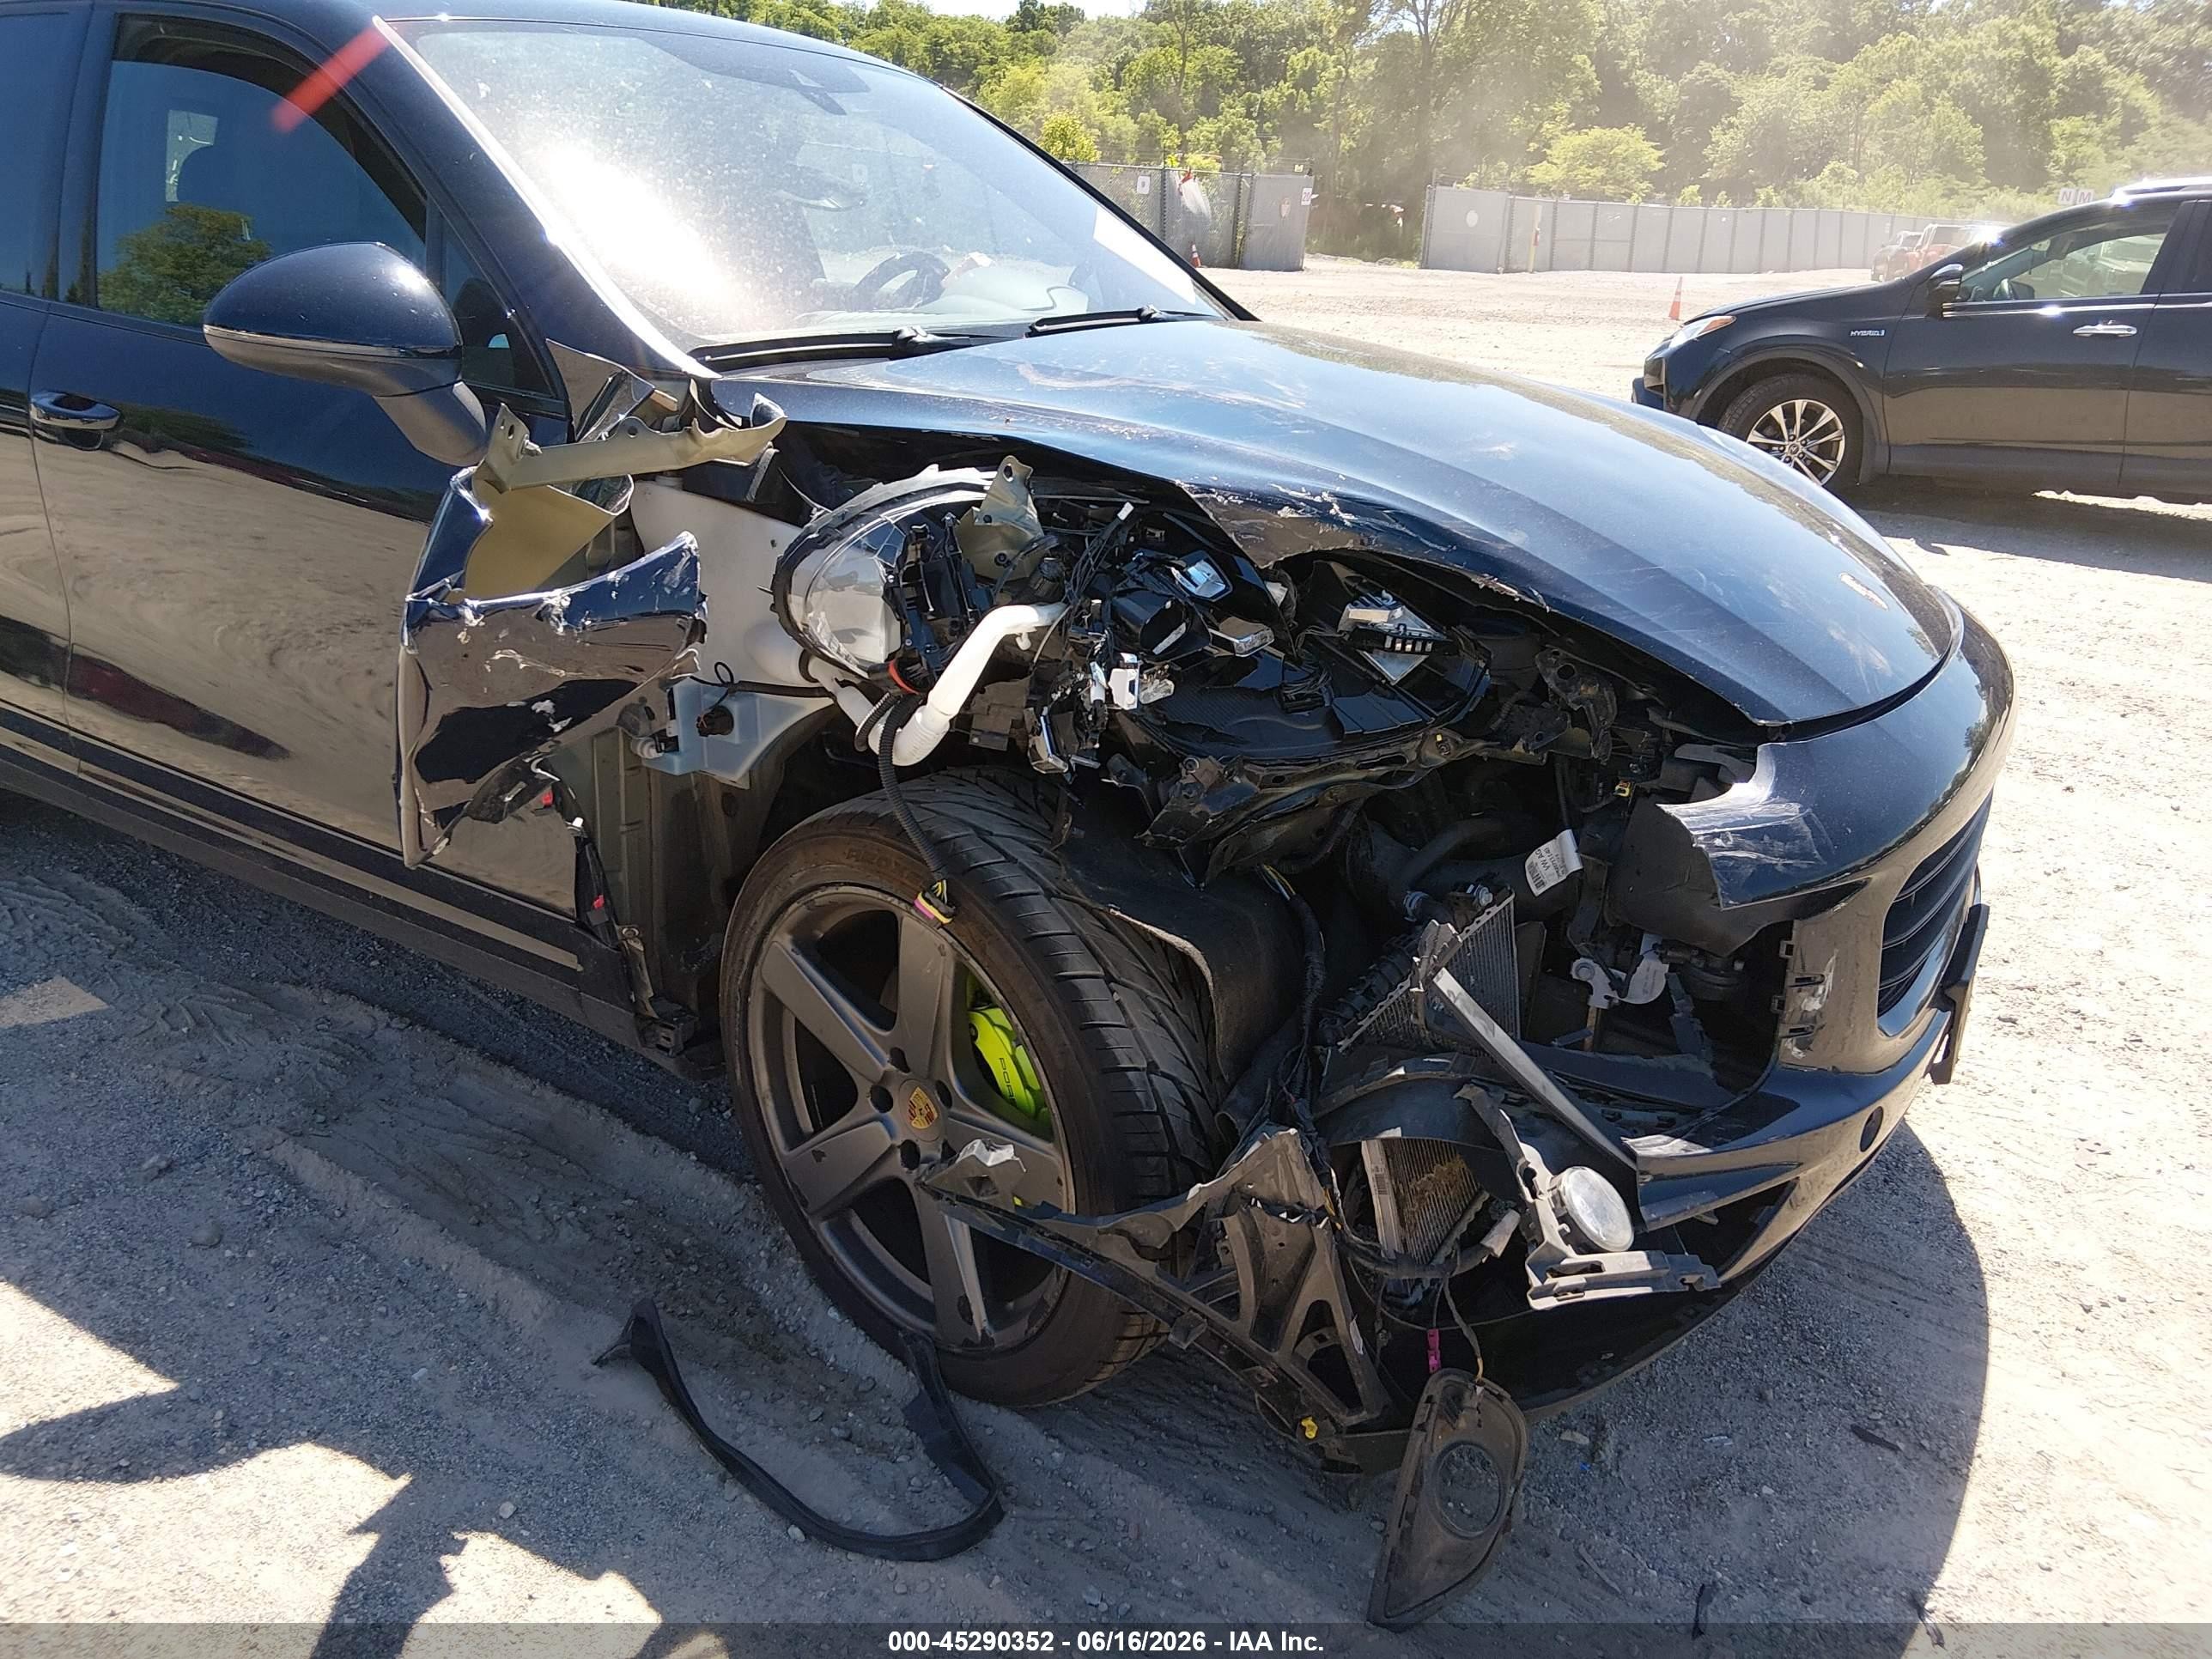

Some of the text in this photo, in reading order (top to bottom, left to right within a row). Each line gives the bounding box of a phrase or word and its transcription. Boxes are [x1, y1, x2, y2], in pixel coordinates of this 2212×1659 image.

[1302, 191, 1311, 202] 20
[2061, 191, 2073, 202] N
[2079, 191, 2092, 204] M
